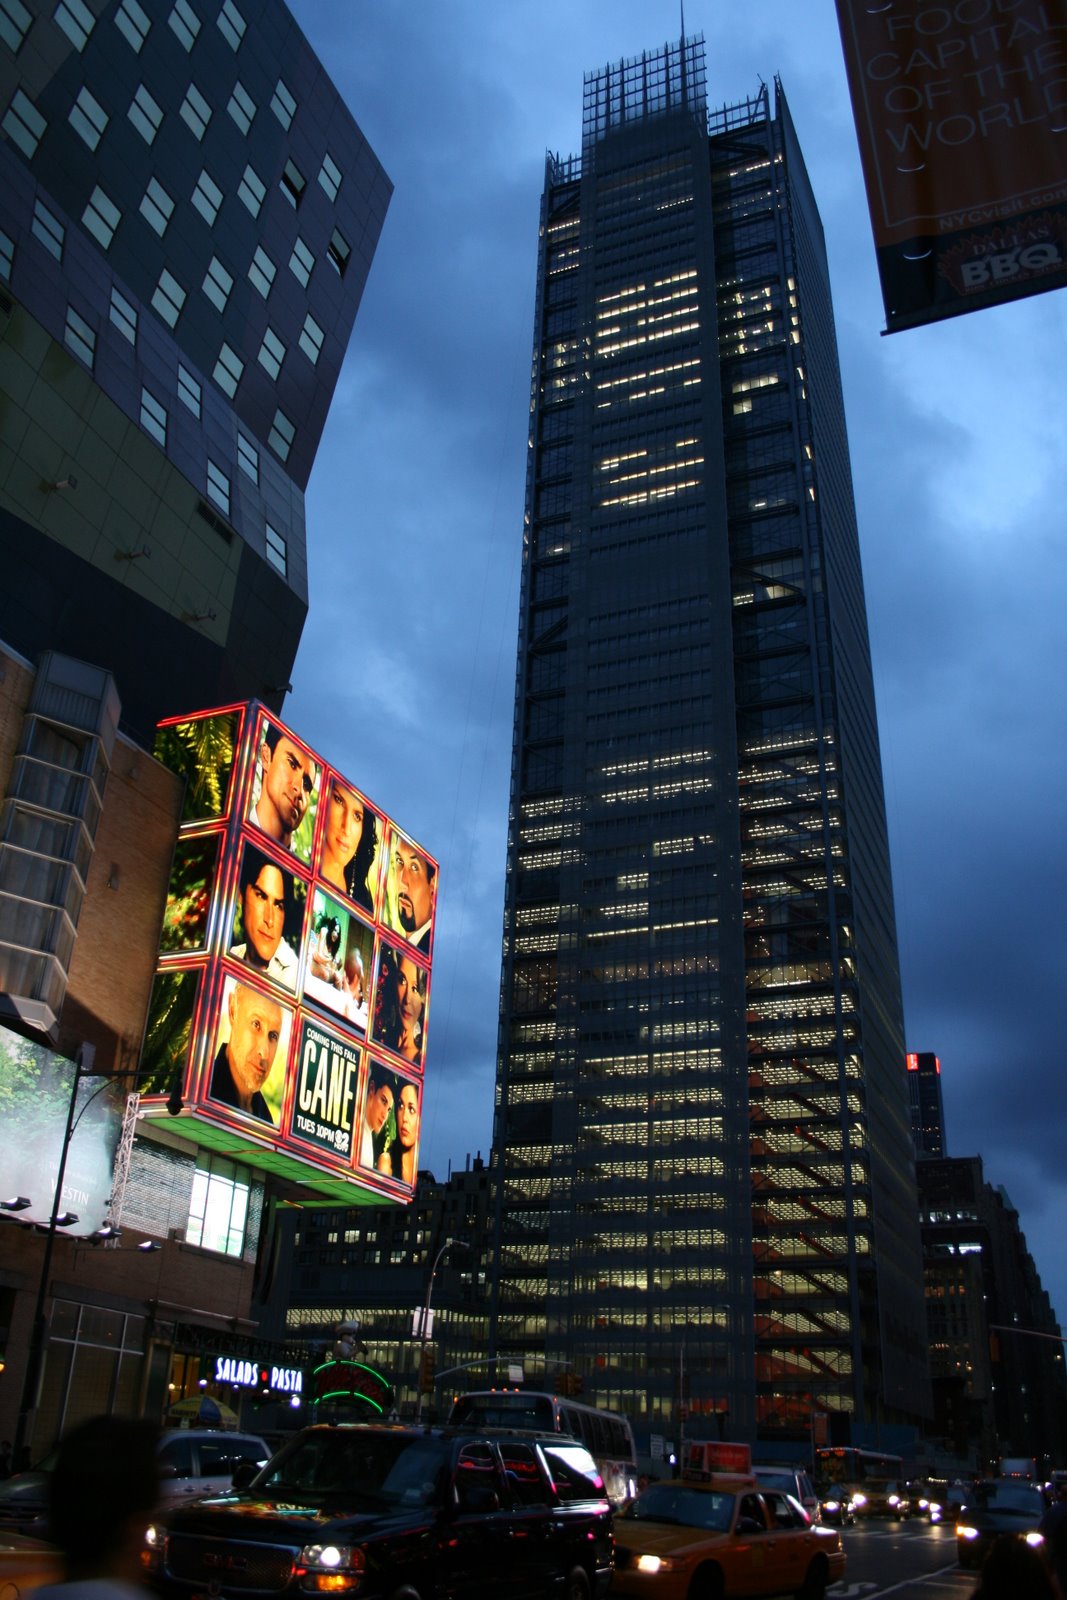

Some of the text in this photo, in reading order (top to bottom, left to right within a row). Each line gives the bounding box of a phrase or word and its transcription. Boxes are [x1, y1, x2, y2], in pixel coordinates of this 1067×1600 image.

[866, 4, 1067, 81] CAPITAL
[884, 39, 1067, 113] OF THE
[885, 78, 1067, 153] WORLD
[938, 188, 1067, 231] NYCvisit.com
[972, 225, 1050, 255] DALLAS
[960, 242, 1064, 288] BBQ
[306, 1027, 356, 1064] COMING THIS FALL
[299, 1039, 356, 1131] CANE
[297, 1115, 316, 1134] TUES
[316, 1123, 334, 1143] 10PM
[215, 1357, 259, 1386] SALADS
[271, 1365, 303, 1393] PASTA
